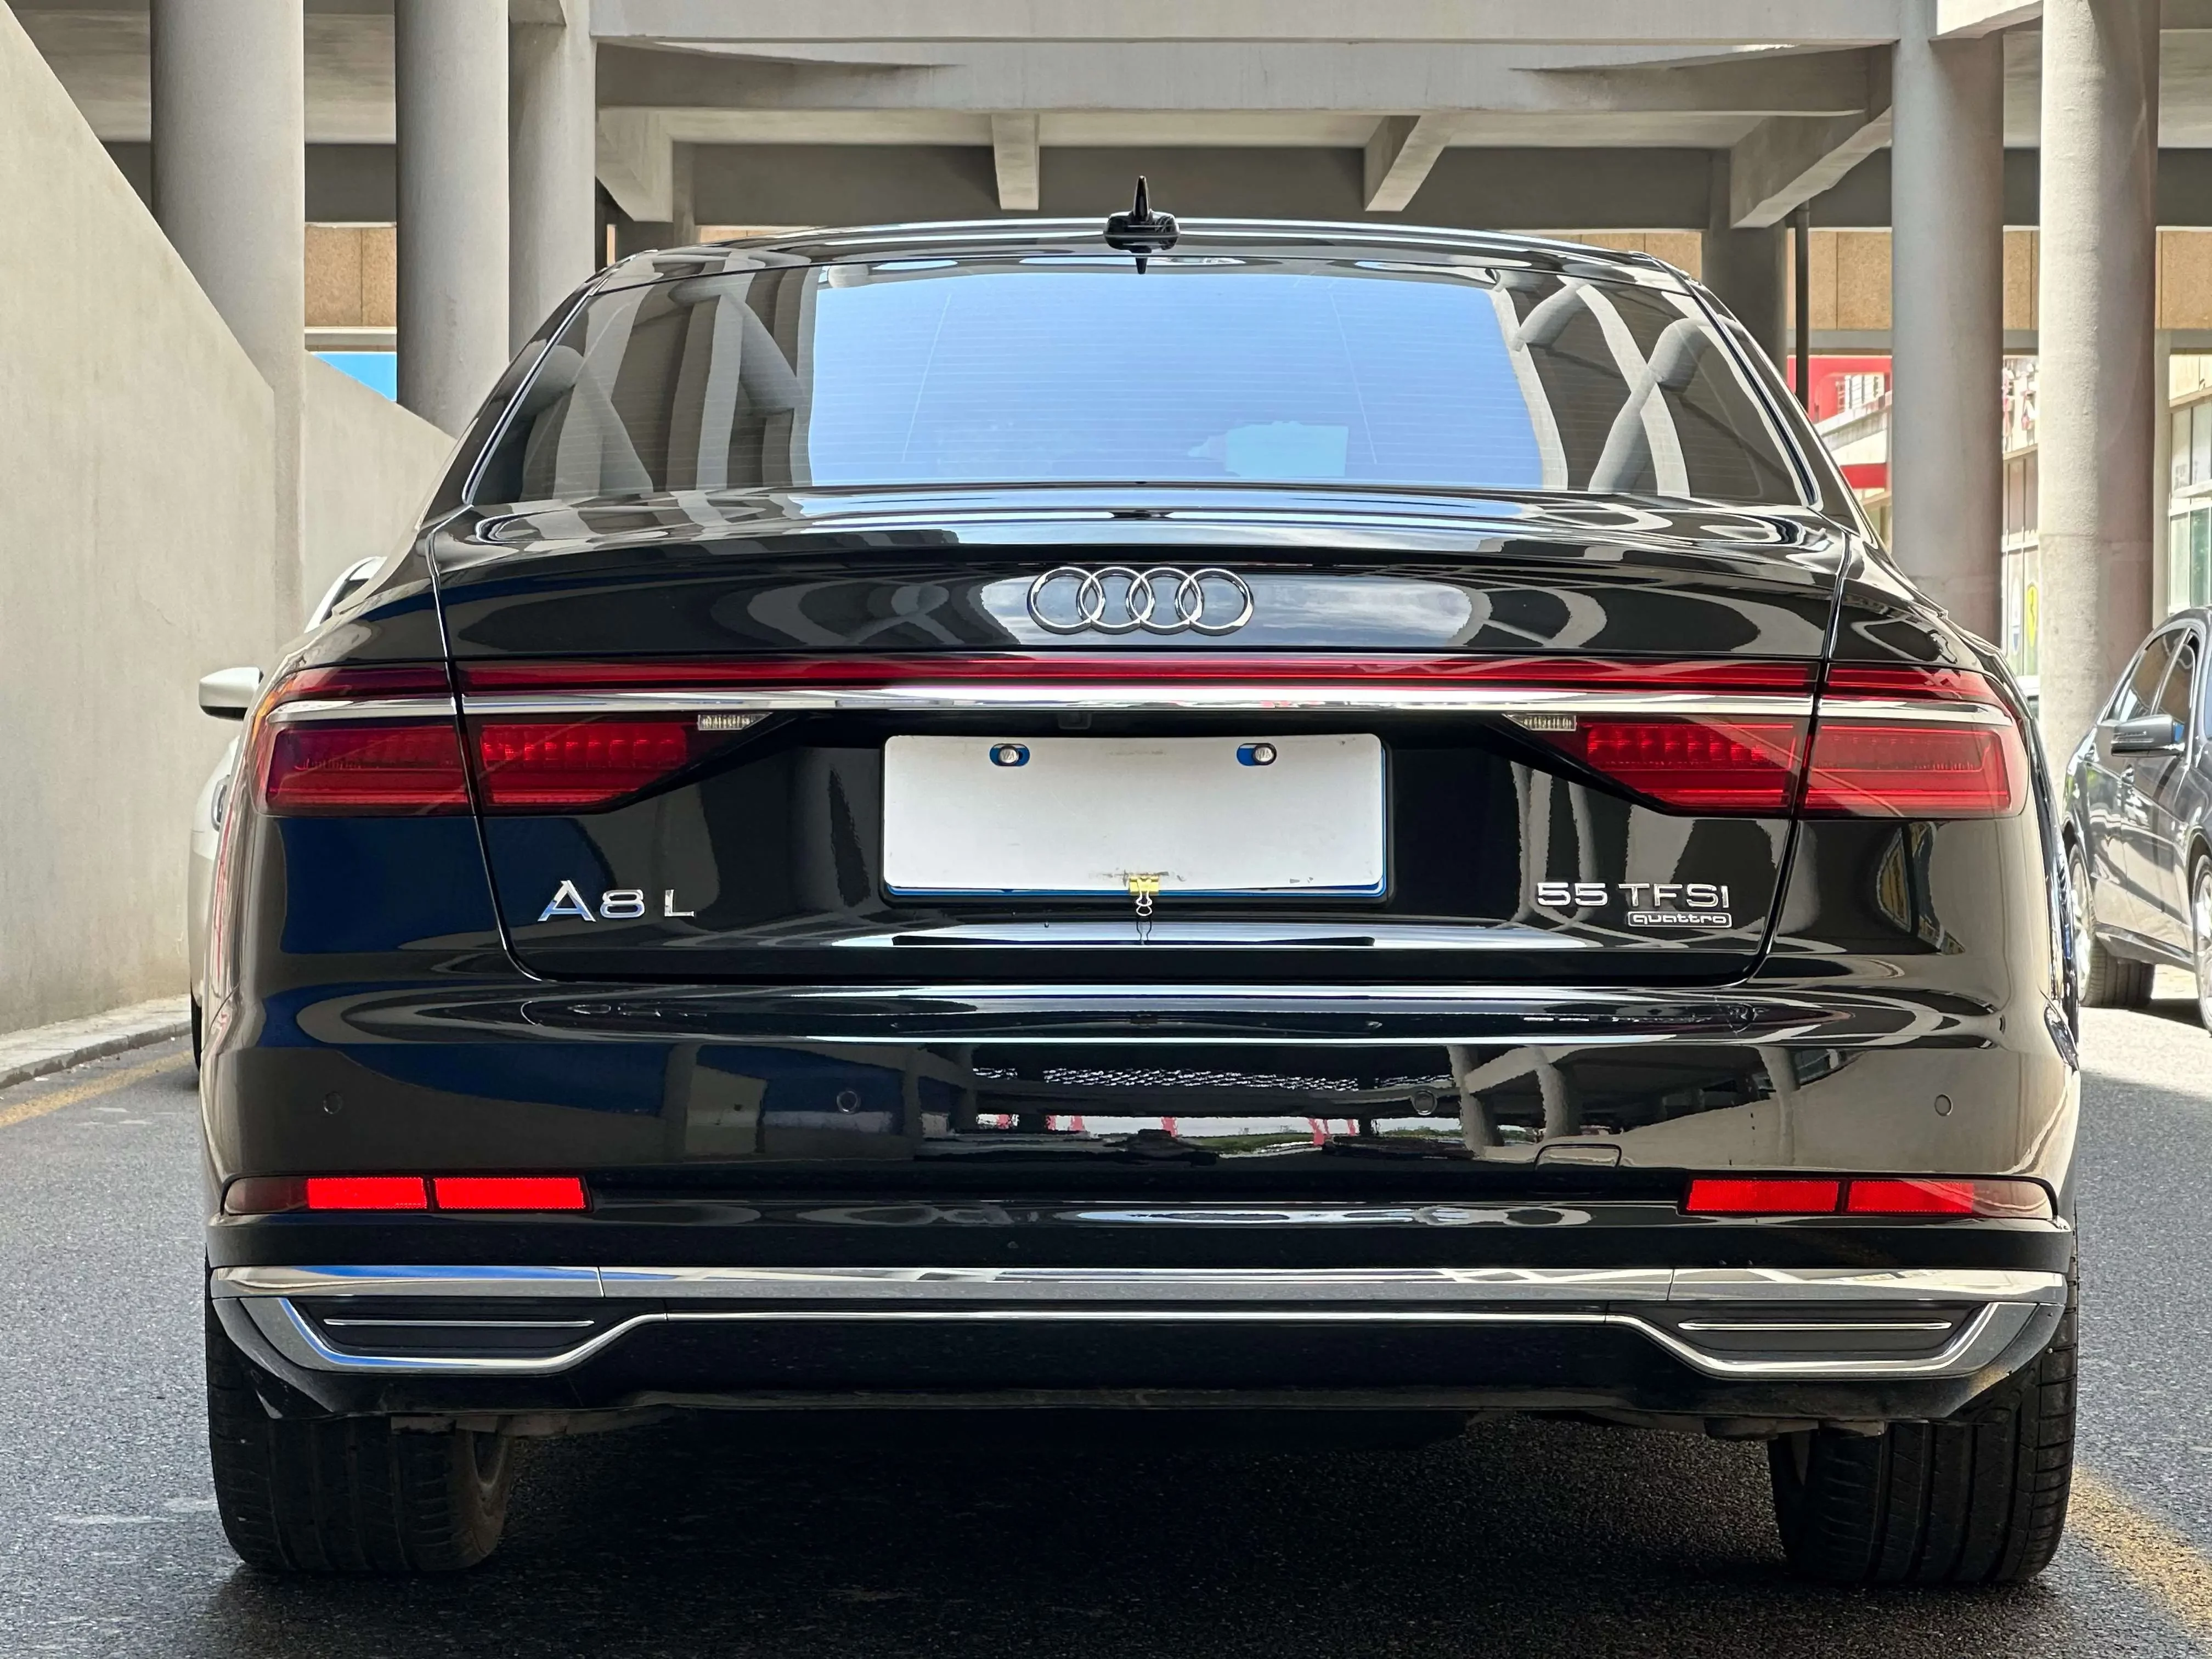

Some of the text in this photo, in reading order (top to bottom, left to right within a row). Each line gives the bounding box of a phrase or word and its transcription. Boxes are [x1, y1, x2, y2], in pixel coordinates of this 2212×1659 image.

[537, 879, 695, 922] A8 L
[1537, 882, 1730, 909] 55 TFSI
[1633, 913, 1727, 925] quattro
